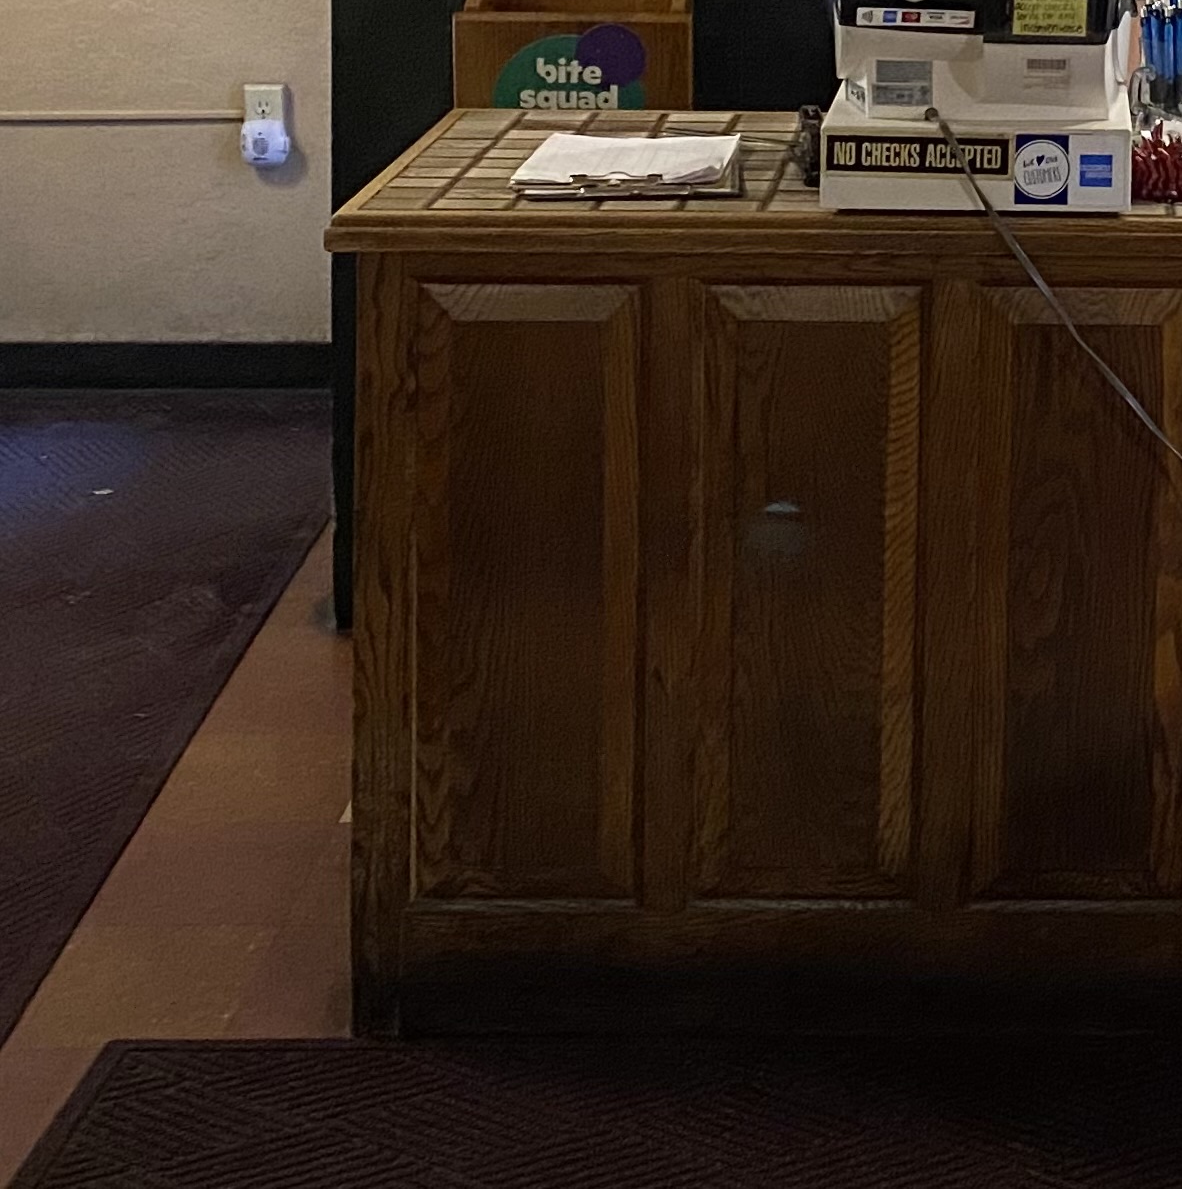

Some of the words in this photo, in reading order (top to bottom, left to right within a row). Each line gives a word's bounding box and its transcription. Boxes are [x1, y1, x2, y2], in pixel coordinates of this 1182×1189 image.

[536, 57, 602, 85] bite
[519, 85, 619, 110] squad
[833, 142, 856, 166] NO
[861, 142, 920, 168] CHECKS
